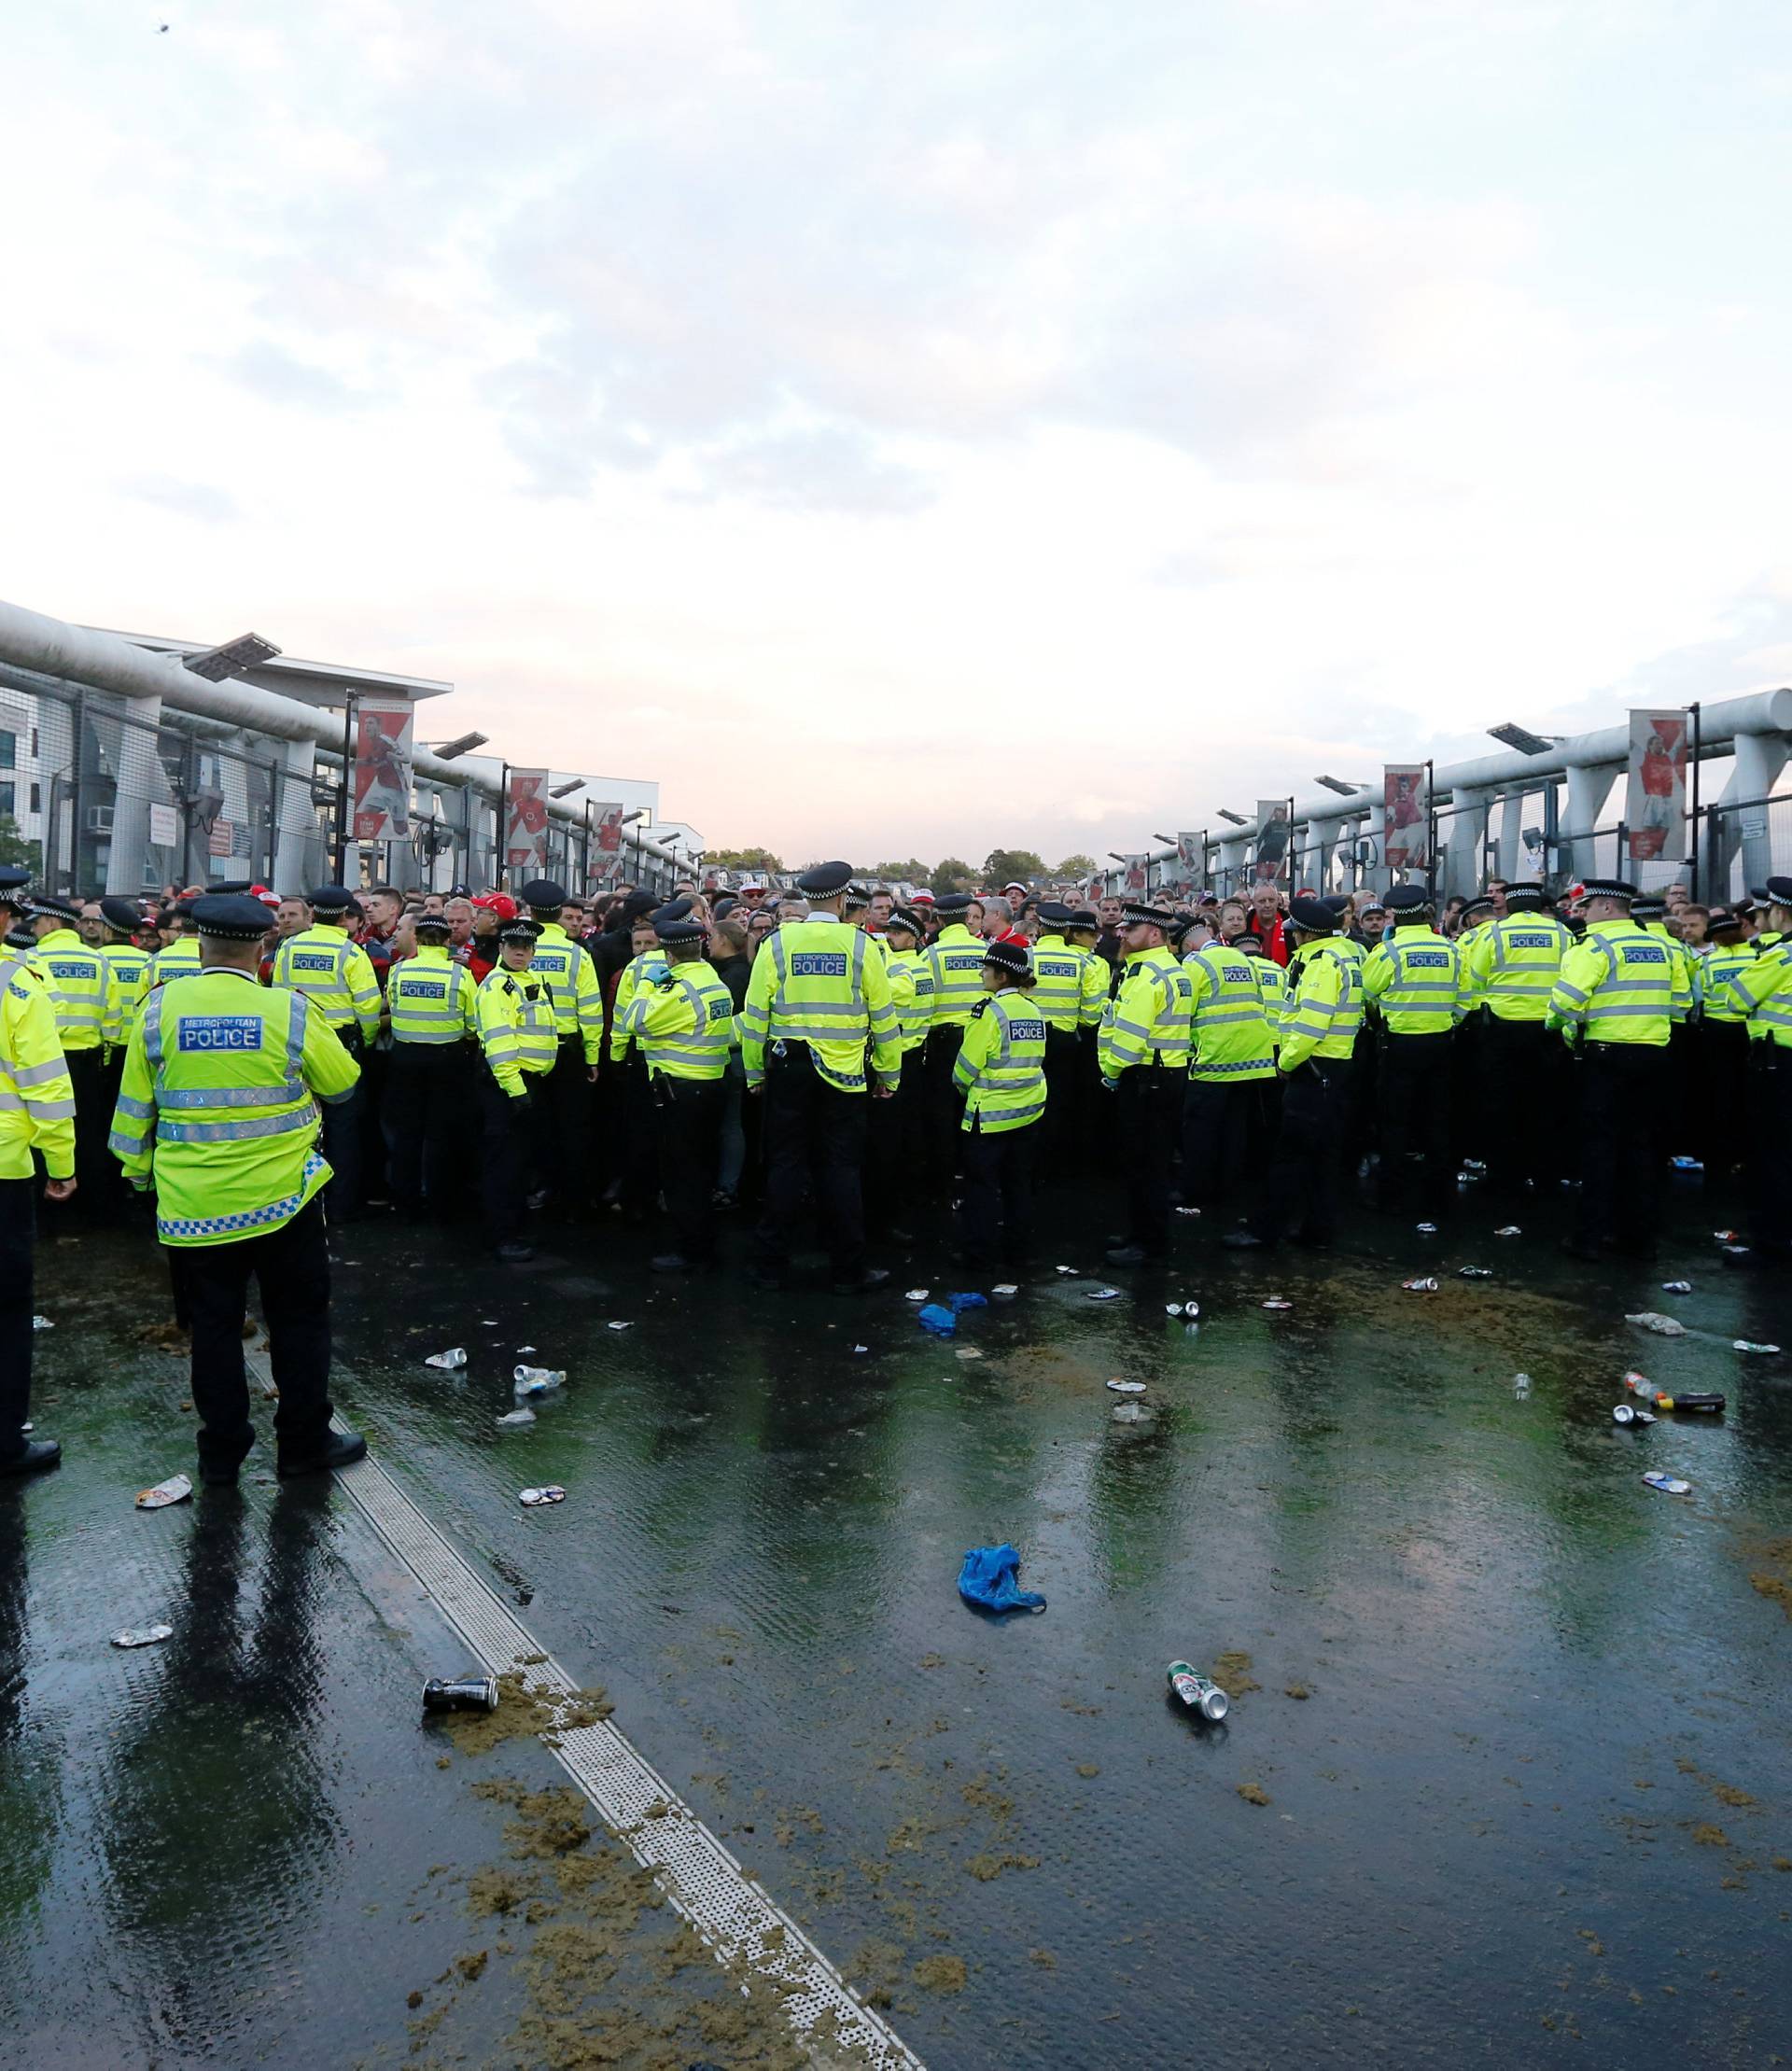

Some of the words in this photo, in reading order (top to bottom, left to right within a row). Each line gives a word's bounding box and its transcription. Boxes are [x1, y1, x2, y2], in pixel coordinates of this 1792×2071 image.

[1510, 938, 1551, 946] POLICE
[1407, 957, 1448, 966] POLICE
[1627, 952, 1665, 962] POLICE
[294, 959, 333, 971] POLICE
[528, 961, 565, 971] OLICE
[793, 961, 845, 974] POLICE
[946, 960, 985, 969] POLICE
[51, 968, 95, 978] POLICE
[1040, 967, 1075, 976] POLICE
[1225, 973, 1252, 981] POLICE
[401, 987, 444, 998] POLICE
[185, 1018, 256, 1028] METROPOLITAN
[186, 1029, 256, 1047] POLICE
[1012, 1028, 1043, 1039] POLICE
